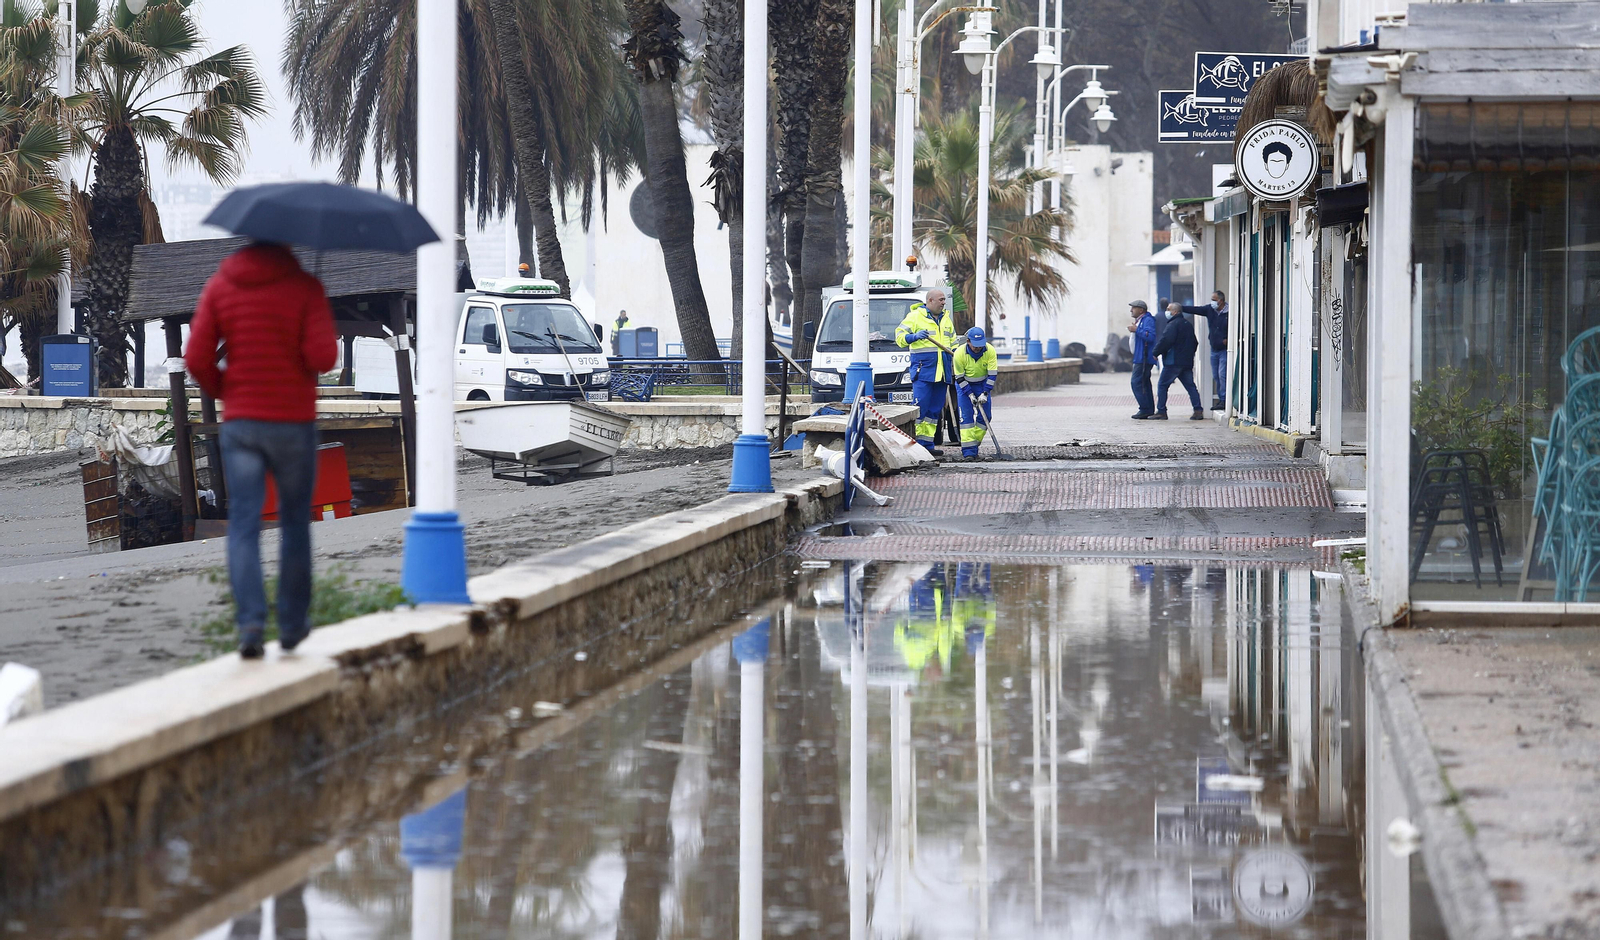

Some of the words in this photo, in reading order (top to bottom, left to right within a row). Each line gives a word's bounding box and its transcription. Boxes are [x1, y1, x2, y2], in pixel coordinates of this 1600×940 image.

[1249, 129, 1275, 149] FRIDA
[1279, 128, 1306, 149] PAHLO
[1257, 179, 1286, 191] MARTES
[577, 357, 600, 366] 9705
